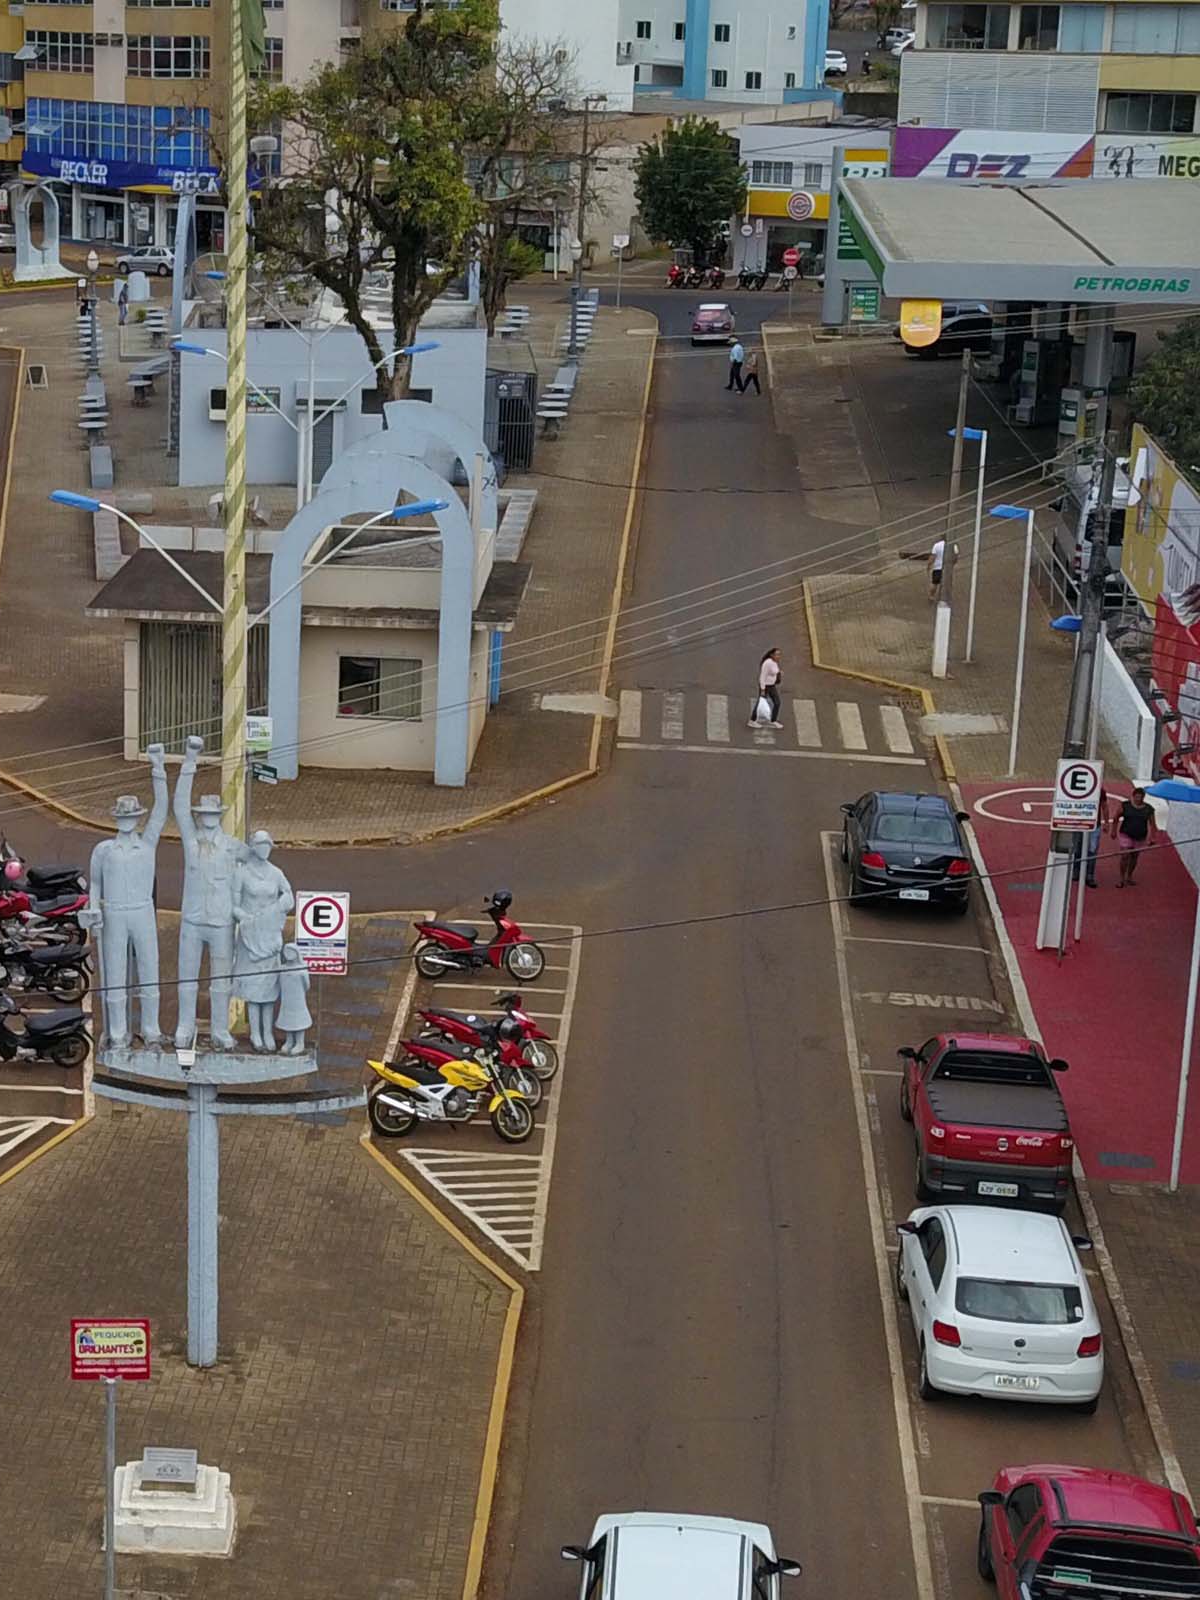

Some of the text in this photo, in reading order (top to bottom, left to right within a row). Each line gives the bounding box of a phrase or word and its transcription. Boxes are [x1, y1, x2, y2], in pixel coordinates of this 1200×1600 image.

[60, 159, 109, 185] BECKER
[946, 153, 1031, 178] DEZ
[1073, 276, 1192, 293] PETROBRAS
[1070, 770, 1089, 791] E
[312, 905, 333, 928] E
[79, 1344, 135, 1354] BRILHANTES
